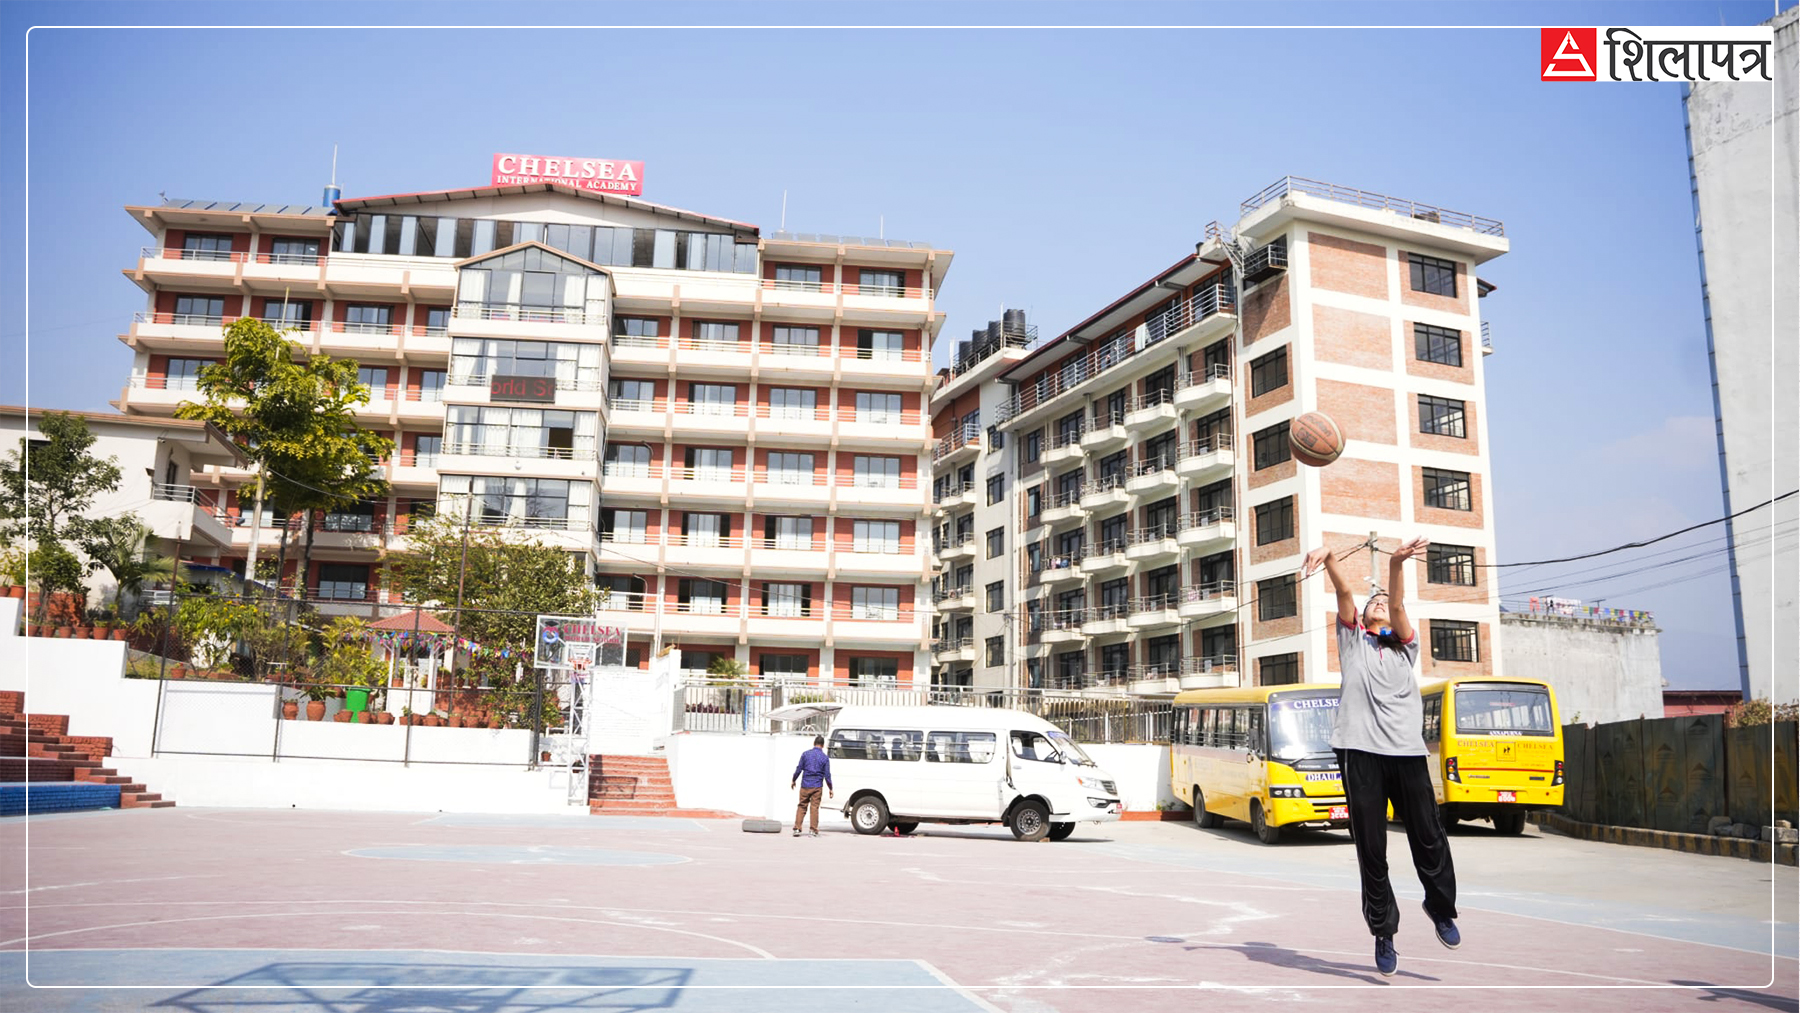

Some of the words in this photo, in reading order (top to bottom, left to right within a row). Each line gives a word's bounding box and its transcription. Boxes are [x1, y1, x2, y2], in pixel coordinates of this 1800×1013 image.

[498, 156, 637, 181] CHELSEA
[587, 181, 637, 191] ACADEMY
[564, 623, 620, 636] CHELSEA
[1293, 698, 1340, 709] CHELSE
[1457, 739, 1495, 748] CHELSEA
